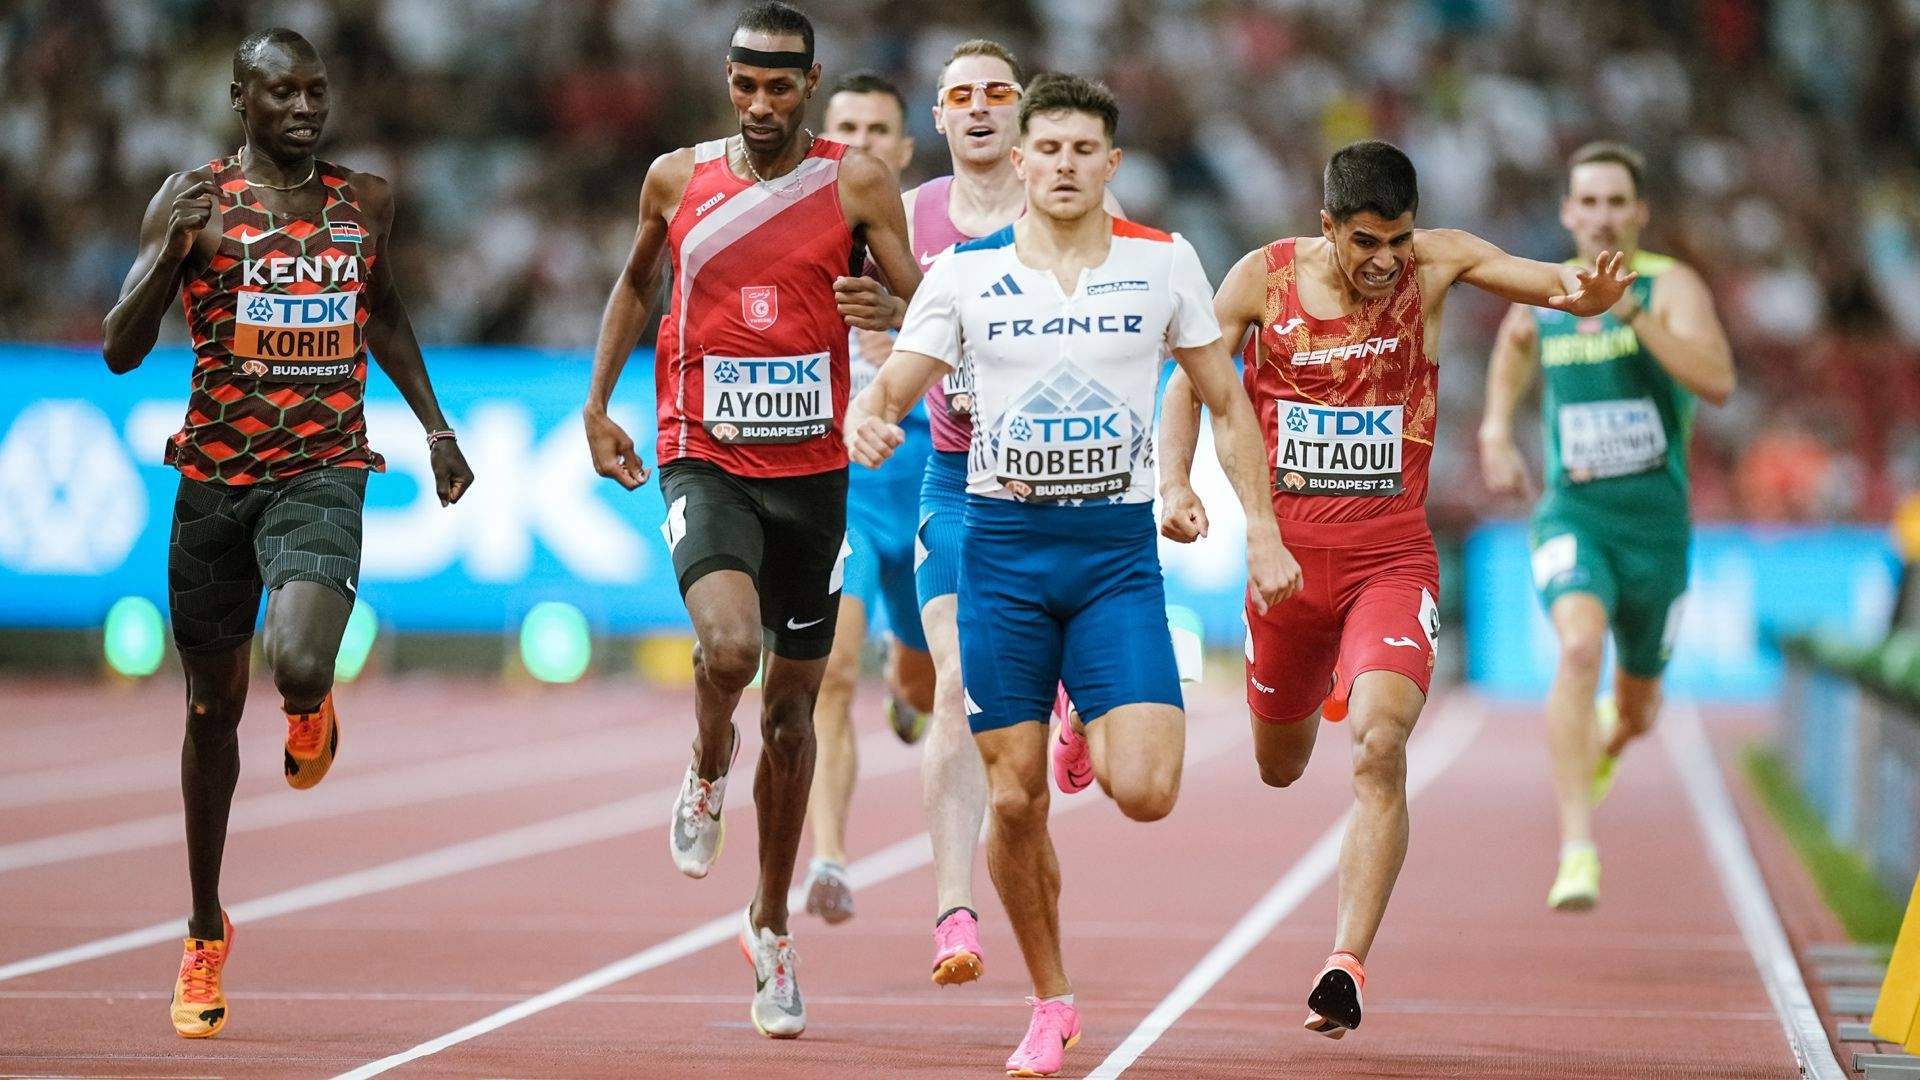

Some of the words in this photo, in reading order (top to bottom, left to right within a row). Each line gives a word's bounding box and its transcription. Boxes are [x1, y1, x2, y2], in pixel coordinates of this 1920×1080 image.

[242, 255, 359, 286] KENYA
[273, 295, 349, 324] TDK
[988, 315, 1143, 341] FRANCE
[256, 329, 340, 358] KORIR
[1290, 336, 1399, 366] ESPAÑA
[272, 365, 338, 376] BUDAPEST
[339, 364, 349, 375] 23
[739, 357, 821, 385] TDK
[715, 390, 820, 418] AYOUNI
[742, 425, 810, 438] BUDAPEST
[811, 424, 826, 435] 23
[1032, 412, 1121, 443] TDK
[1308, 408, 1393, 436] TDK
[1005, 444, 1123, 476] ROBERT
[1282, 438, 1394, 471] ATTAOUI
[1034, 482, 1107, 497] BUDAPEST
[1107, 478, 1123, 491] 23
[1309, 478, 1378, 490] BUDAPEST
[1379, 478, 1394, 489] 23
